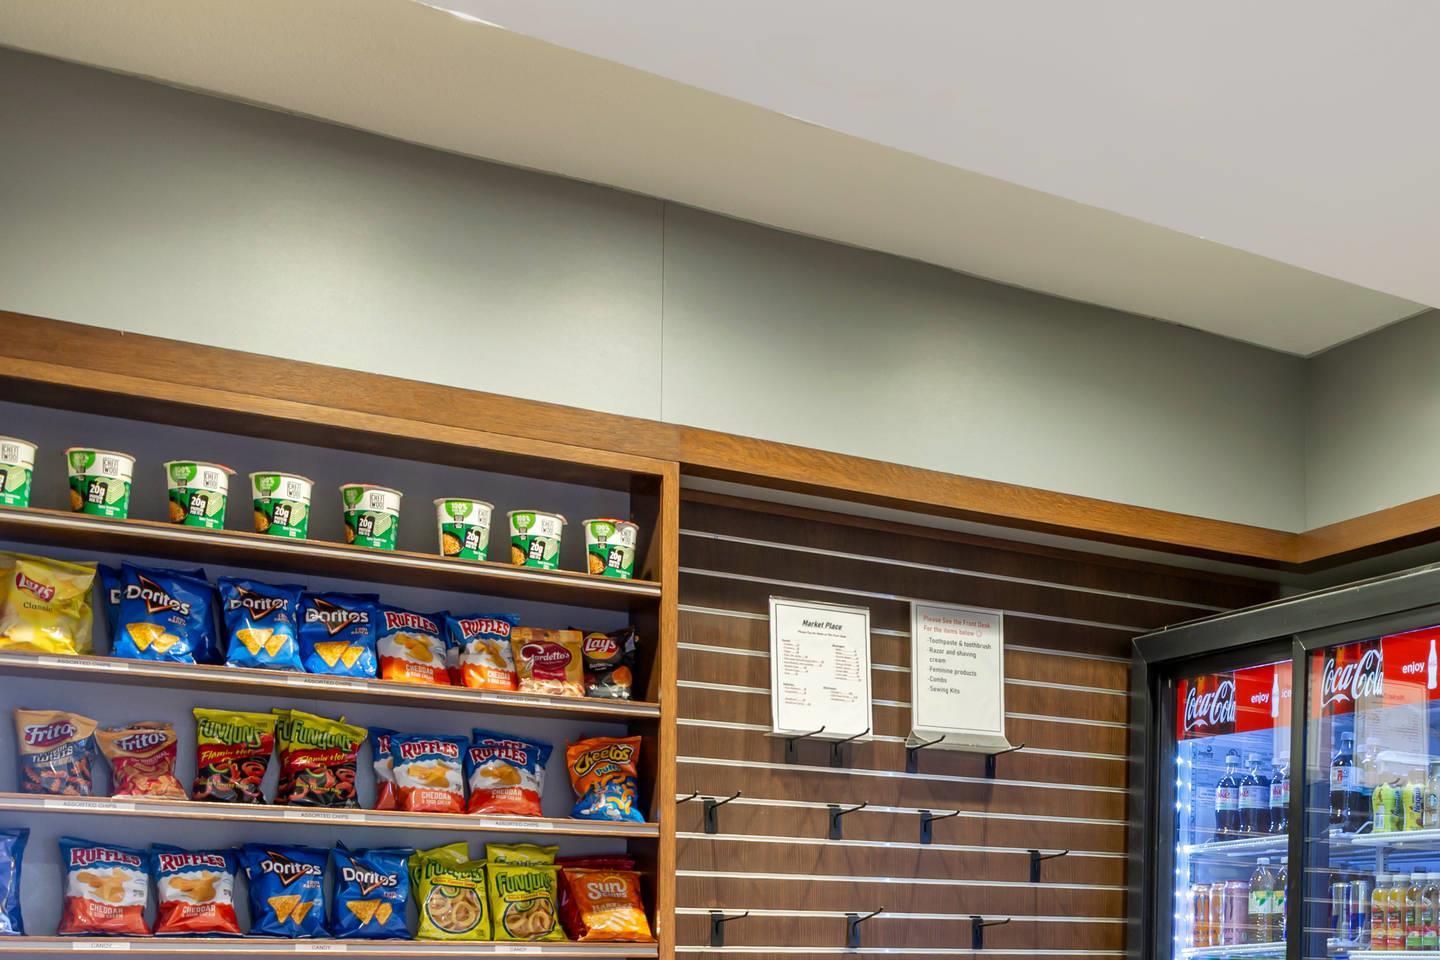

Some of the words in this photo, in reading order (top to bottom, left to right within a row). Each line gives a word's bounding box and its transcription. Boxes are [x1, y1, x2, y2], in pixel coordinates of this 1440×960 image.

[90, 483, 105, 497] 20g
[191, 495, 206, 509] 20g
[274, 506, 289, 518] 20g
[358, 517, 373, 530] 20g
[467, 532, 479, 544] 20g
[530, 542, 543, 554] 20g
[609, 551, 622, 563] 20g
[23, 601, 53, 613] Classic
[126, 584, 191, 616] Doritos
[305, 607, 369, 623] Doritos
[384, 611, 439, 634] RUFFLES
[459, 618, 511, 639] RUFFLES
[802, 619, 825, 629] Market
[825, 621, 843, 631] Place
[929, 637, 958, 648] Toothpaste
[963, 641, 992, 650] toothbrush
[929, 648, 945, 656] Razor
[956, 650, 977, 659] shaving
[929, 665, 953, 674] Feminine
[954, 667, 977, 677] products
[929, 676, 947, 684] Combs
[1321, 649, 1383, 708] Coca-Cola
[1402, 661, 1425, 675] enjoy
[929, 685, 949, 695] Sewing
[949, 687, 960, 695] Kits
[1184, 680, 1236, 732] Coca-Cola
[1250, 692, 1270, 704] enjoy
[113, 732, 167, 750] Fritos
[400, 741, 459, 759] RUFFLES
[471, 748, 528, 765] RUFFLES
[575, 745, 631, 774] Cheetos
[70, 847, 141, 867] RUFFLES
[159, 853, 226, 872] RUFFLES
[260, 859, 322, 876] Doritos
[342, 867, 398, 887] Doritos
[183, 904, 216, 914] CHEDDAR
